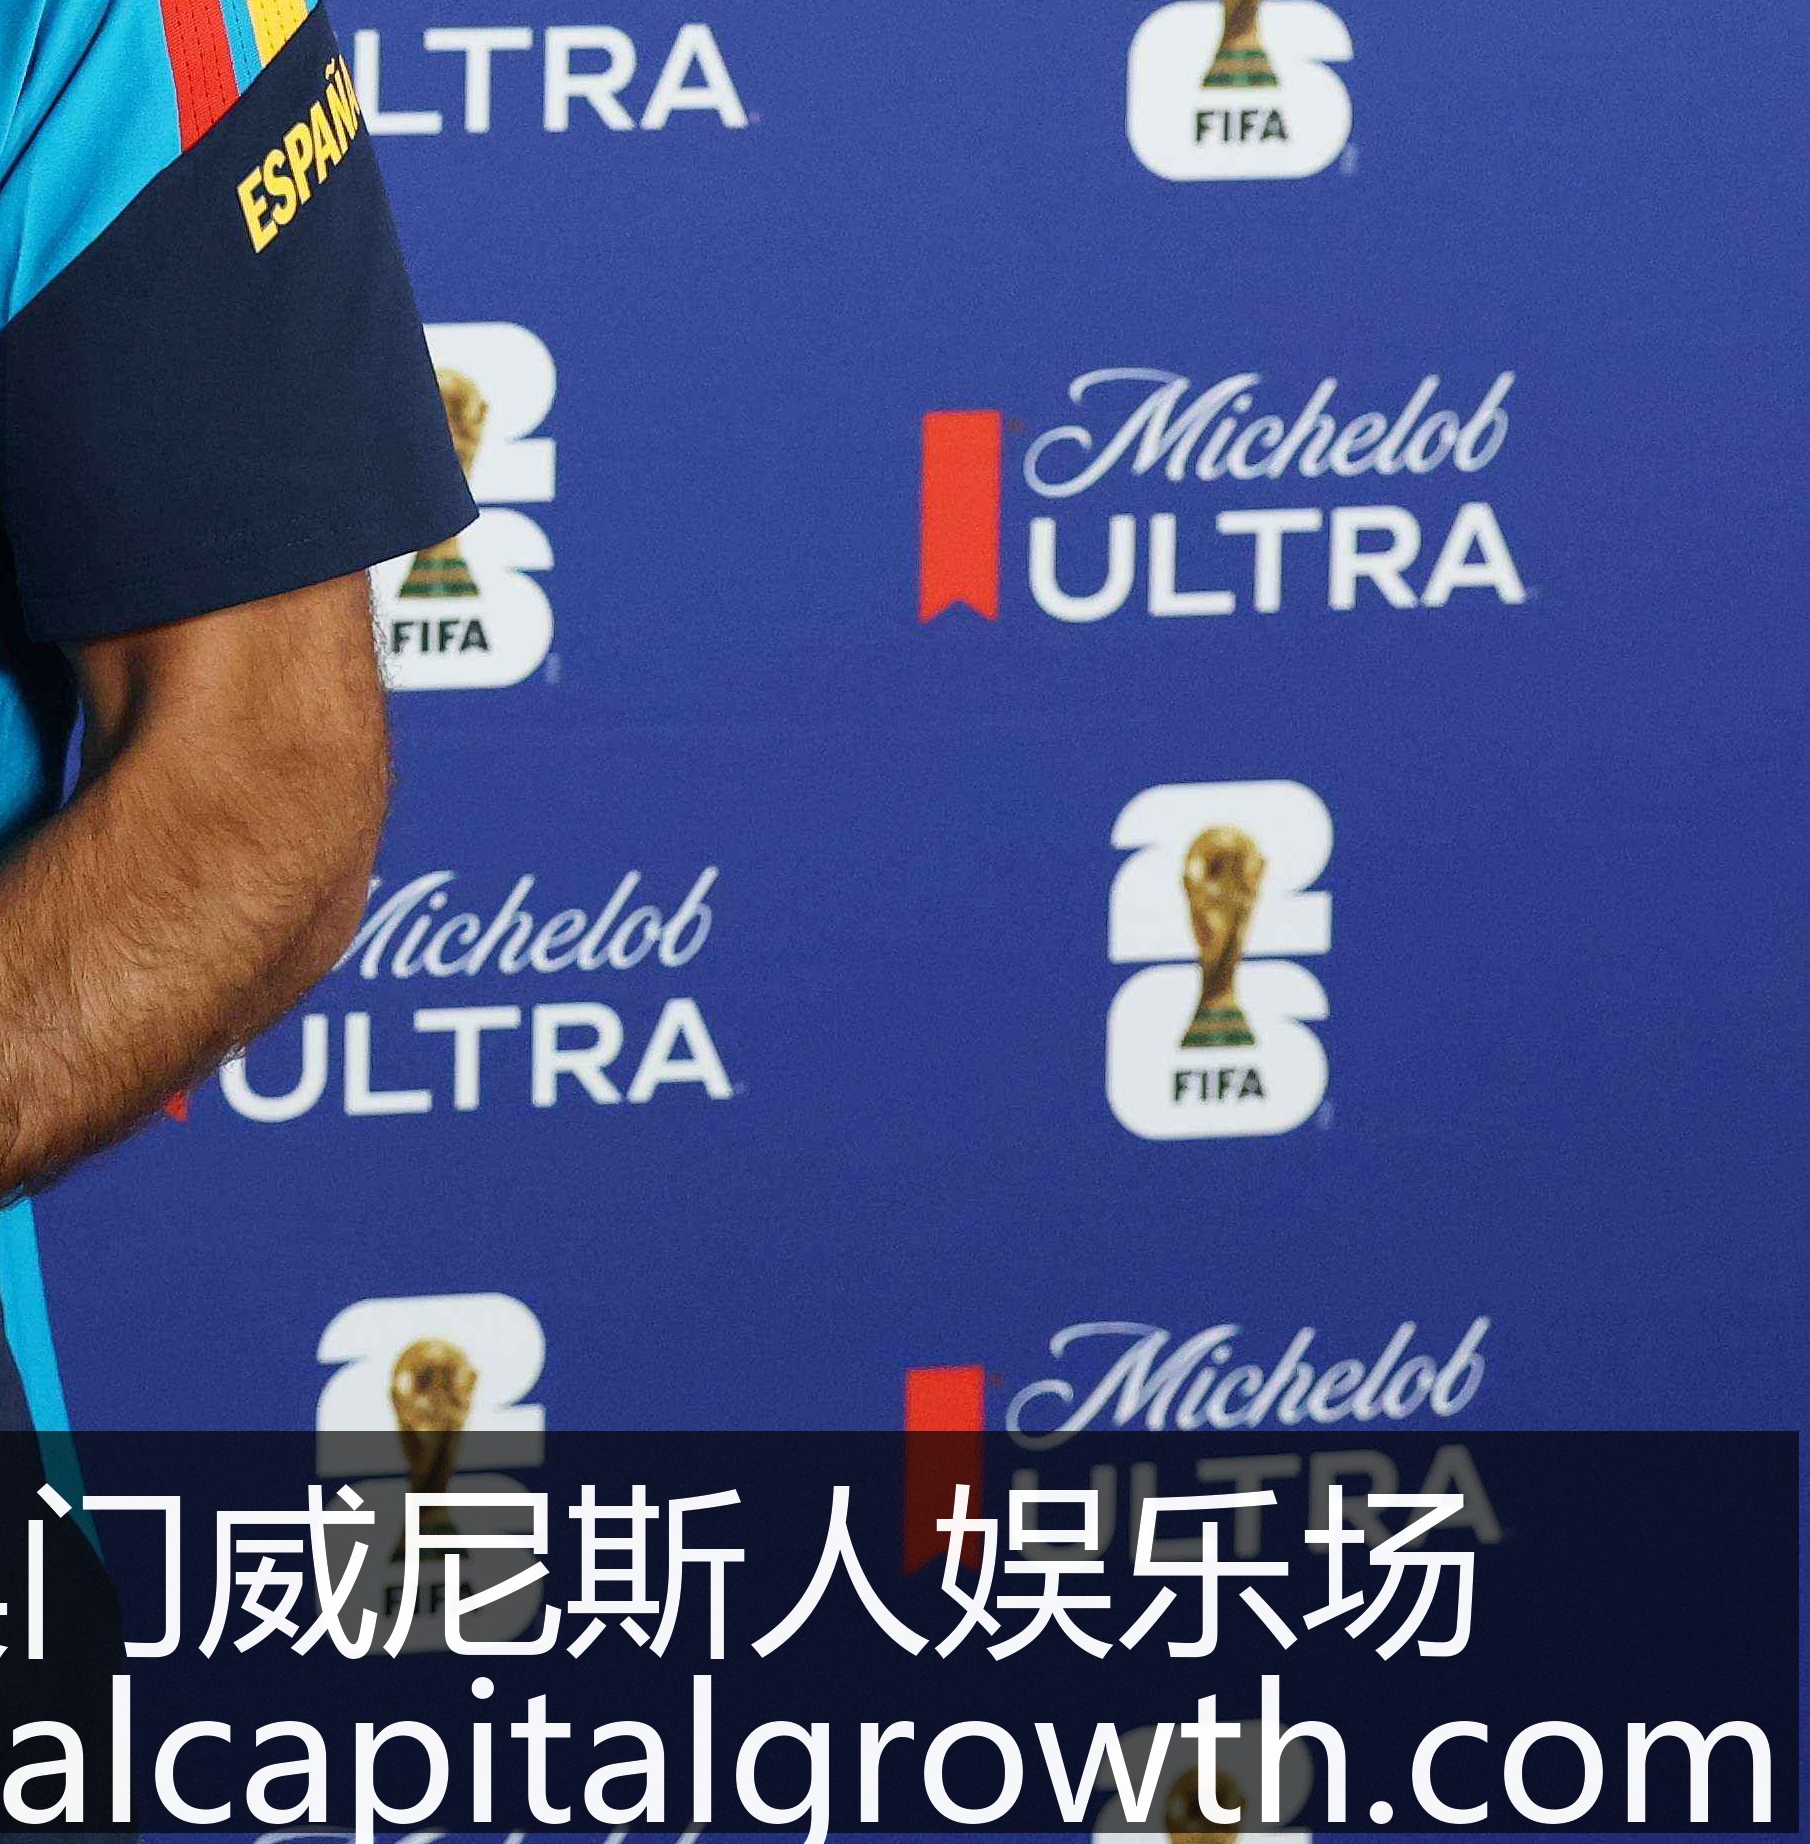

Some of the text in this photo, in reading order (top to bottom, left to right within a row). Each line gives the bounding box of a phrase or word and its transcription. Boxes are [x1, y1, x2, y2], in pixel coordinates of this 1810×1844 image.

[352, 22, 750, 137] LTRA
[1194, 108, 1289, 144] FIFA
[1023, 366, 1516, 499] Michelob
[1027, 501, 1528, 624] ULTRA
[391, 619, 489, 655] FIFA
[216, 996, 735, 1125] ULTRA
[1173, 1067, 1265, 1103] FIFA
[1004, 1314, 1493, 1452] Michelob
